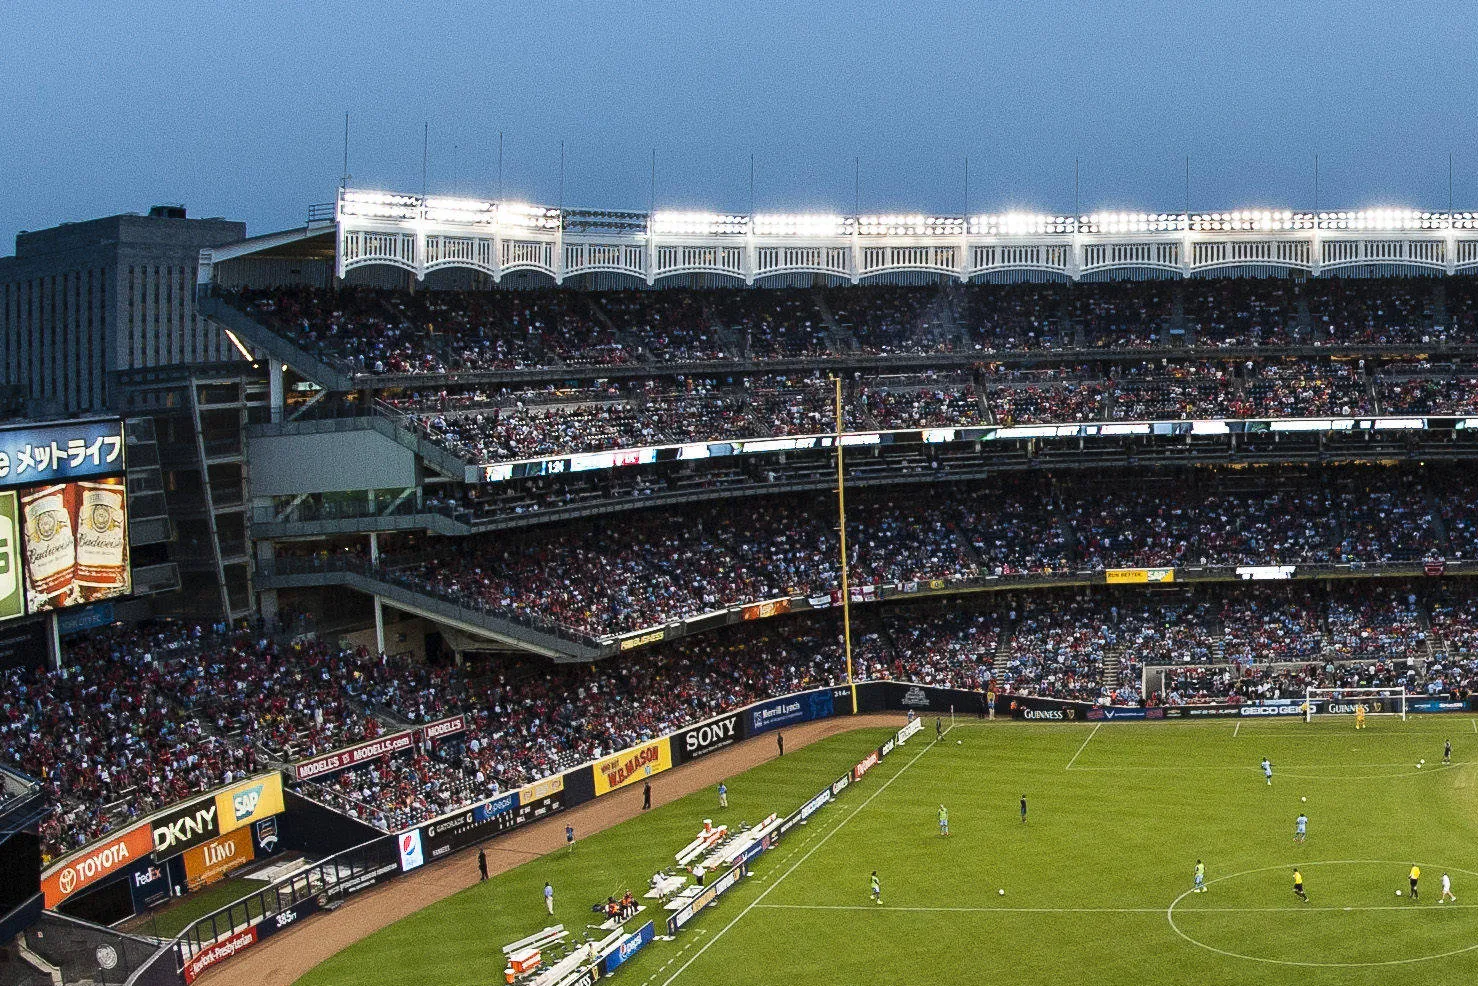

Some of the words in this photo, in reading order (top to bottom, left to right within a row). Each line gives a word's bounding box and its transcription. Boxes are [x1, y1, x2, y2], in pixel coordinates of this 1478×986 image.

[17, 436, 120, 474] メットライフ
[783, 702, 800, 714] Lynch
[1024, 709, 1063, 719] GUINNESS
[1241, 706, 1278, 715] GEICO
[686, 717, 737, 751] SONY
[234, 797, 258, 817] SAP
[153, 805, 216, 851] DKNY
[76, 842, 129, 881] TOYOTA
[134, 867, 162, 888] FedEx
